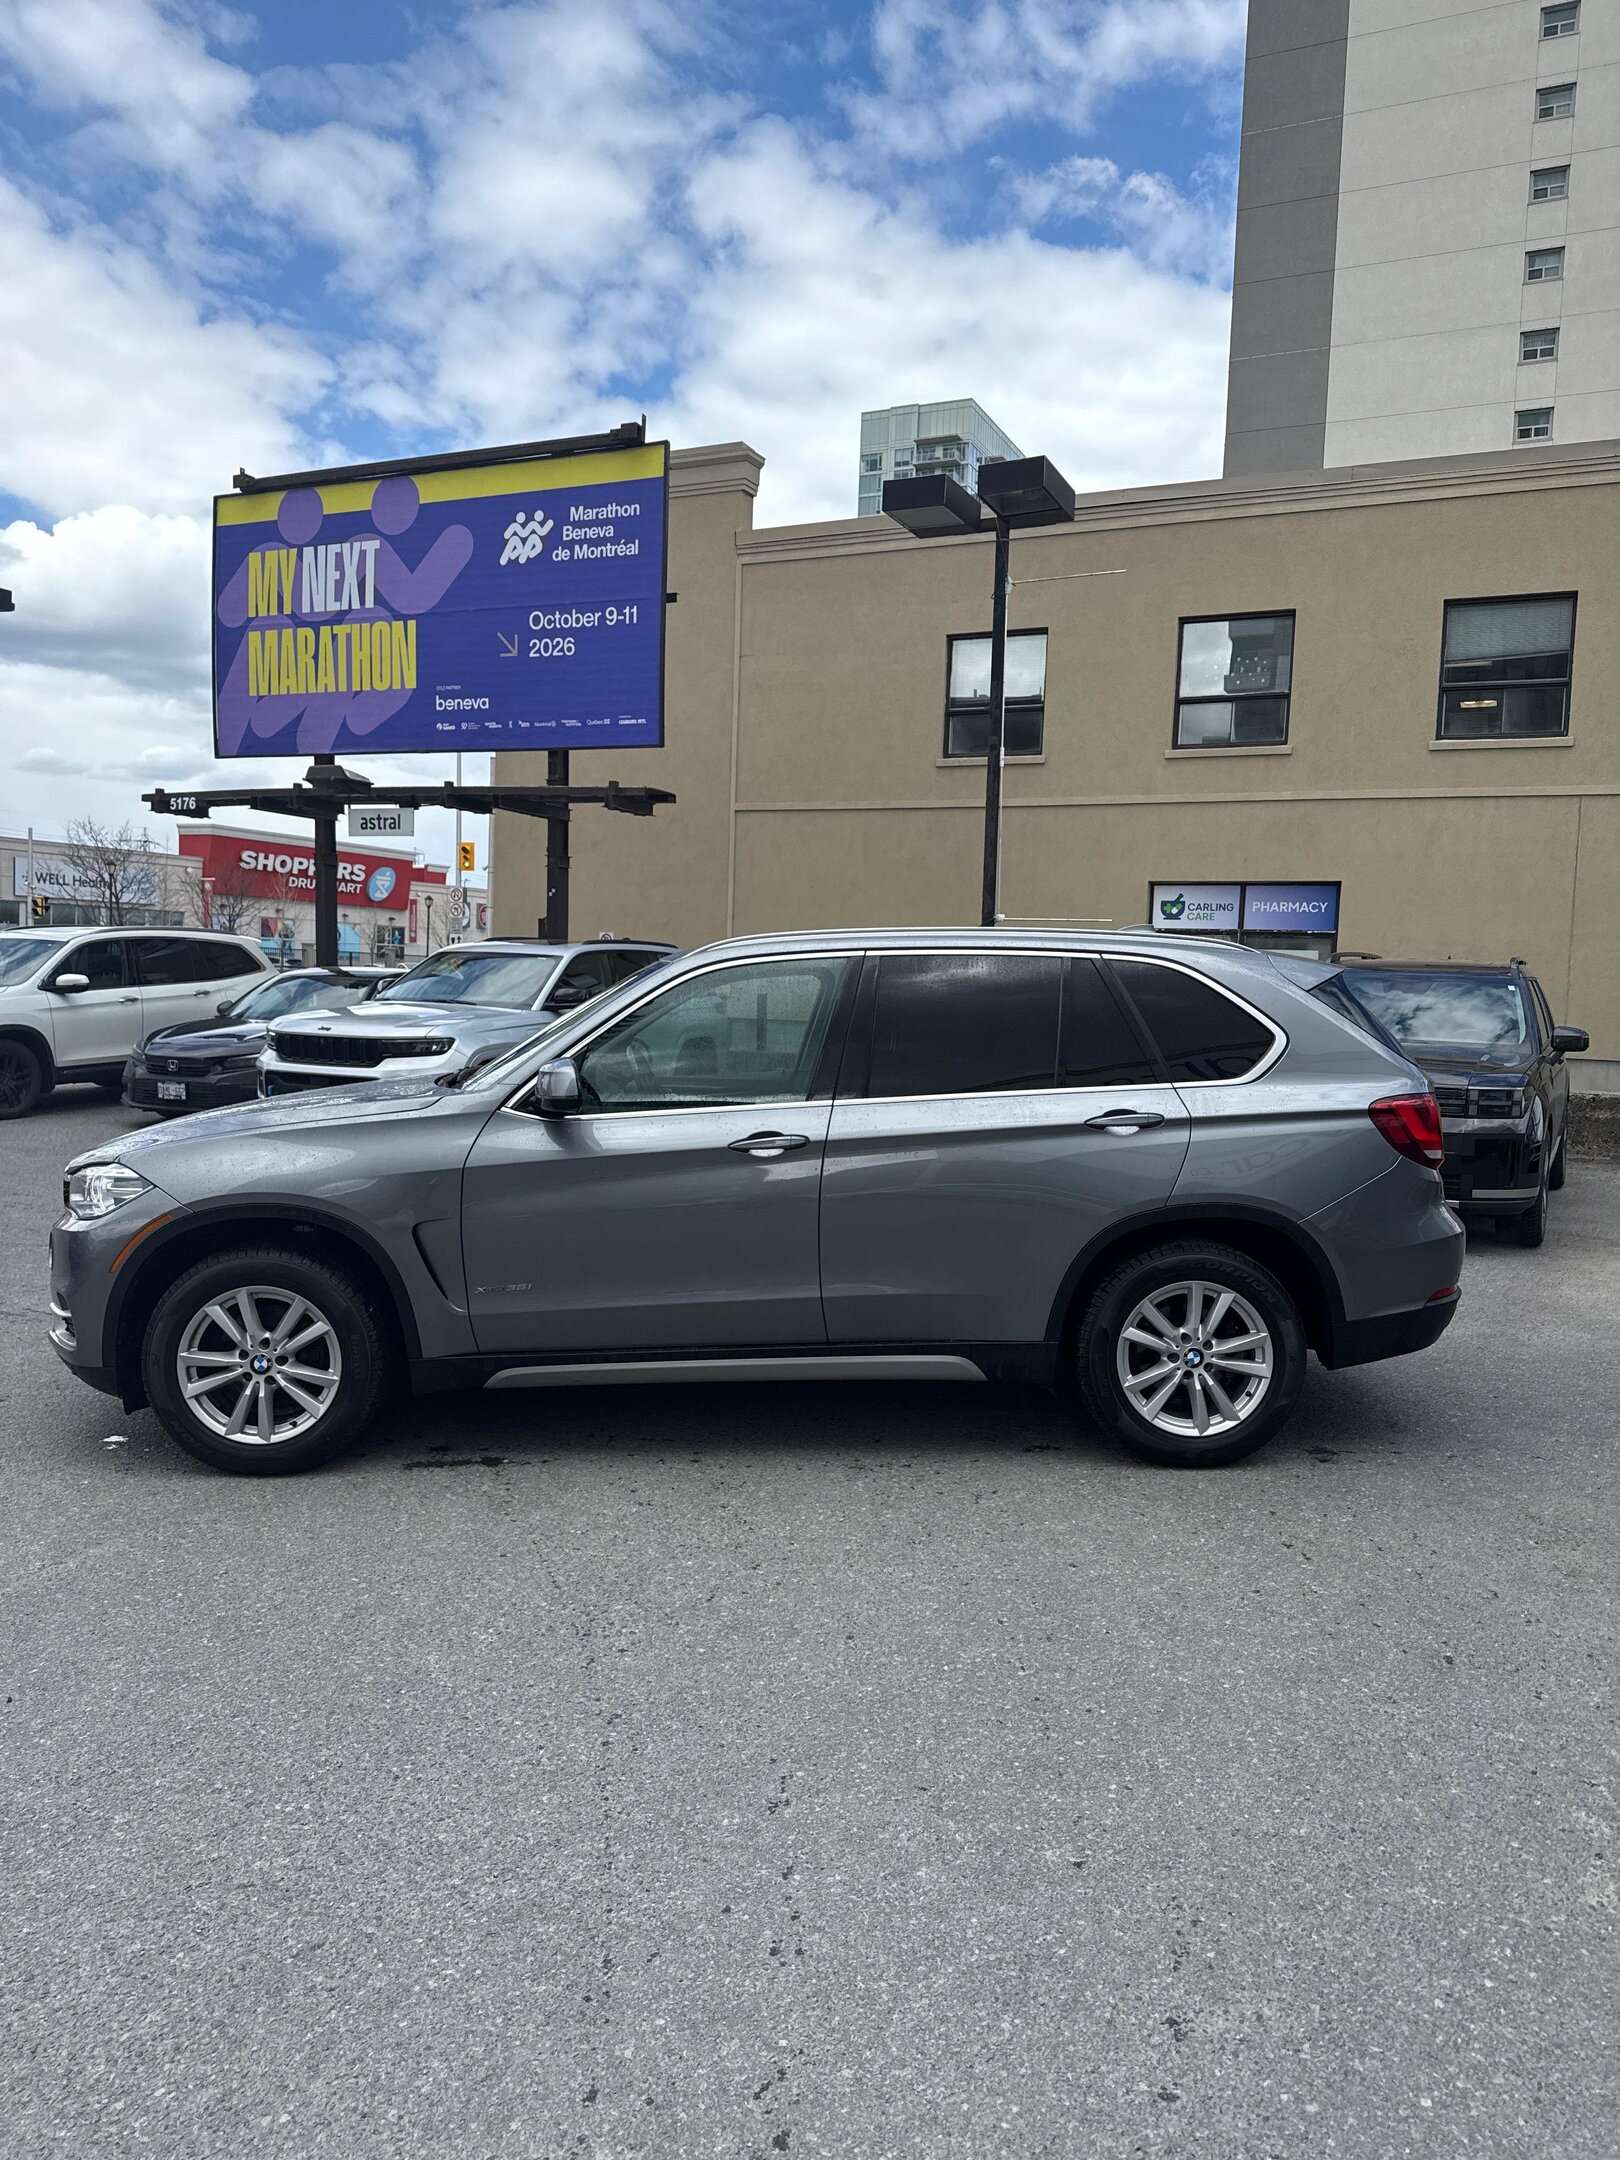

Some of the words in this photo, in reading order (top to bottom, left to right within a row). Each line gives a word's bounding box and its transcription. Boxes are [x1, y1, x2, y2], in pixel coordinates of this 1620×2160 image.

[569, 502, 640, 522] Marathon
[562, 524, 614, 541] Beneva
[552, 546, 571, 561] de
[573, 539, 639, 560] Montréal
[247, 548, 298, 618] MY
[301, 539, 380, 613] NEXT
[529, 608, 601, 630] October
[605, 605, 638, 626] 9-11
[529, 637, 575, 658] 2026
[248, 620, 417, 697] MARATHON
[435, 695, 489, 711] beneva
[169, 797, 196, 810] 5176
[360, 814, 401, 831] astral
[239, 850, 366, 882] SHOPRS
[34, 871, 70, 886] WELL
[288, 876, 316, 889] DRU
[336, 881, 363, 894] ART
[1187, 902, 1234, 912] CARLING
[1252, 901, 1329, 913] PHARMACY
[1186, 912, 1216, 921] CARE
